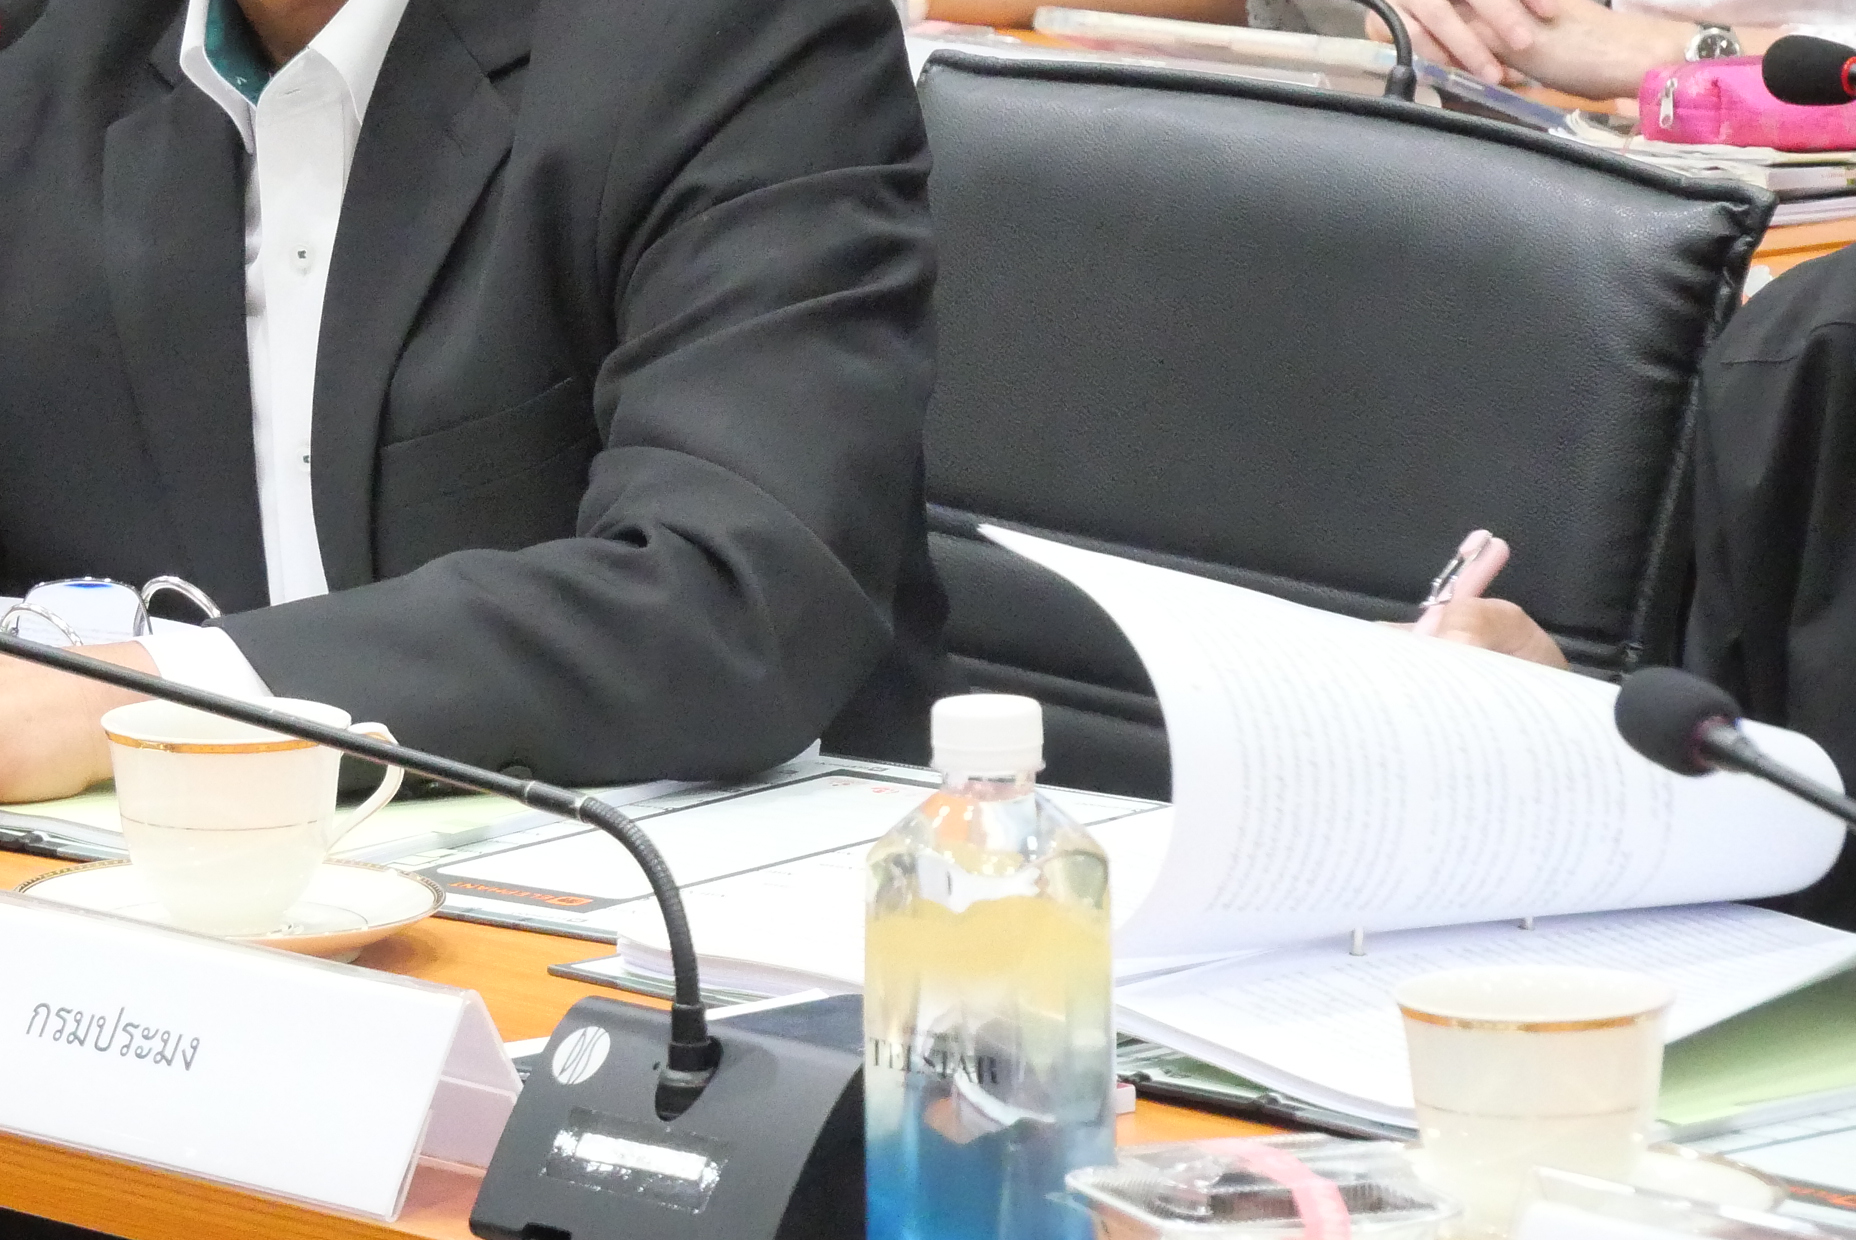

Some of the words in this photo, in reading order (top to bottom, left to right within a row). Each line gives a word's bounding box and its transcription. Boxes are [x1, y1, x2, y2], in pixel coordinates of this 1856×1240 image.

[447, 881, 555, 901] ELEPHANT
[25, 1002, 201, 1072] กรมประมง
